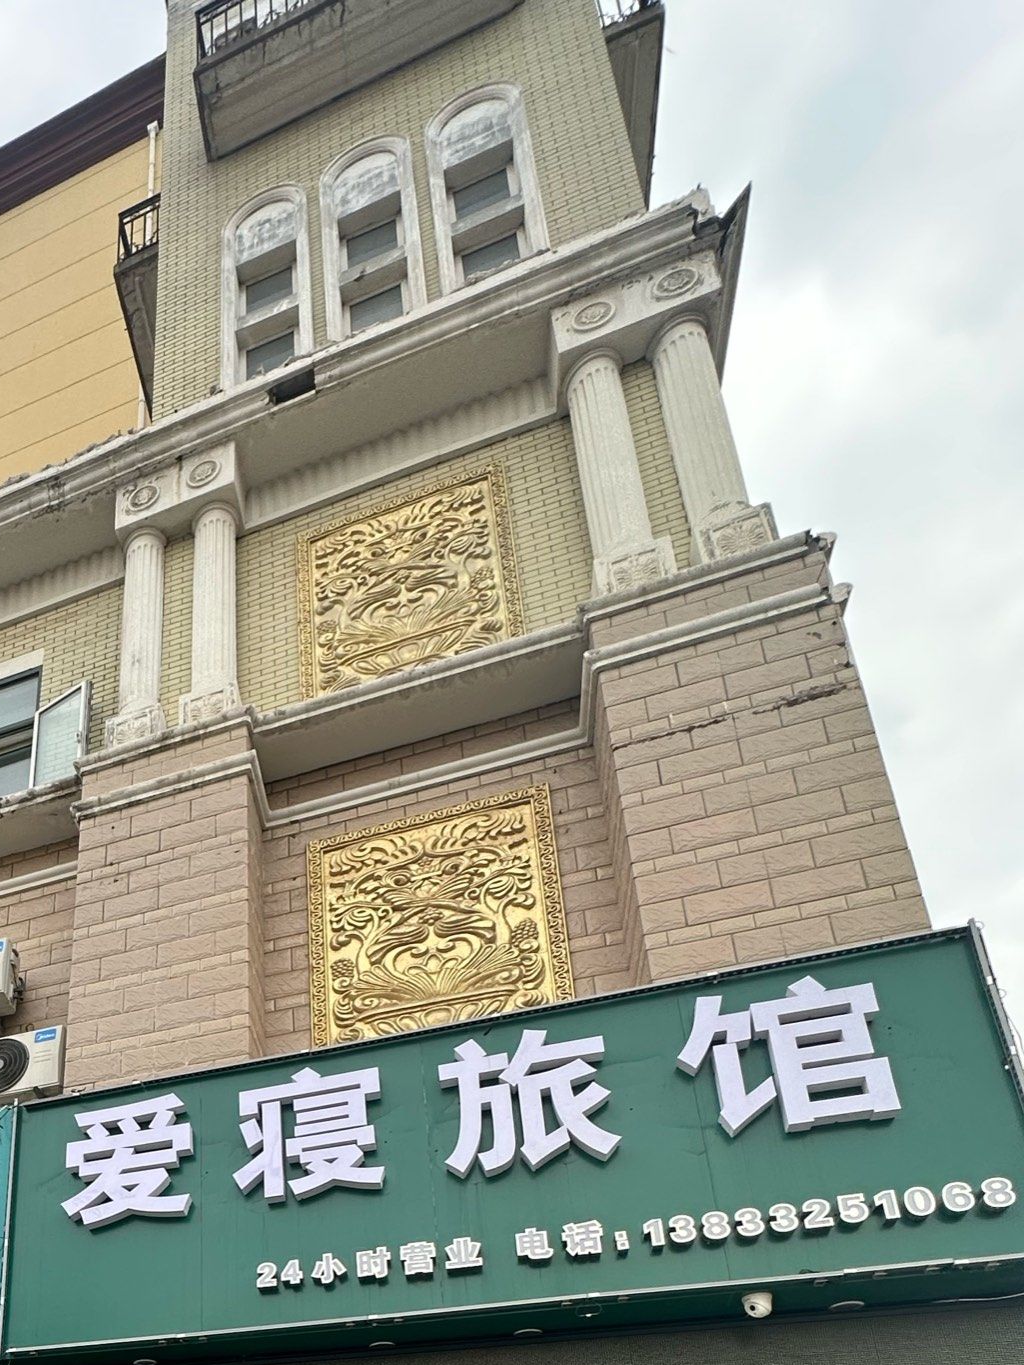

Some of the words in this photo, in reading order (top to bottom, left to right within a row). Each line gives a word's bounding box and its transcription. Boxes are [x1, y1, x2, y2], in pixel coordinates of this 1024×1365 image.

[60, 974, 902, 1231] 爱寝旅馆
[255, 1235, 484, 1290] 24小时营业
